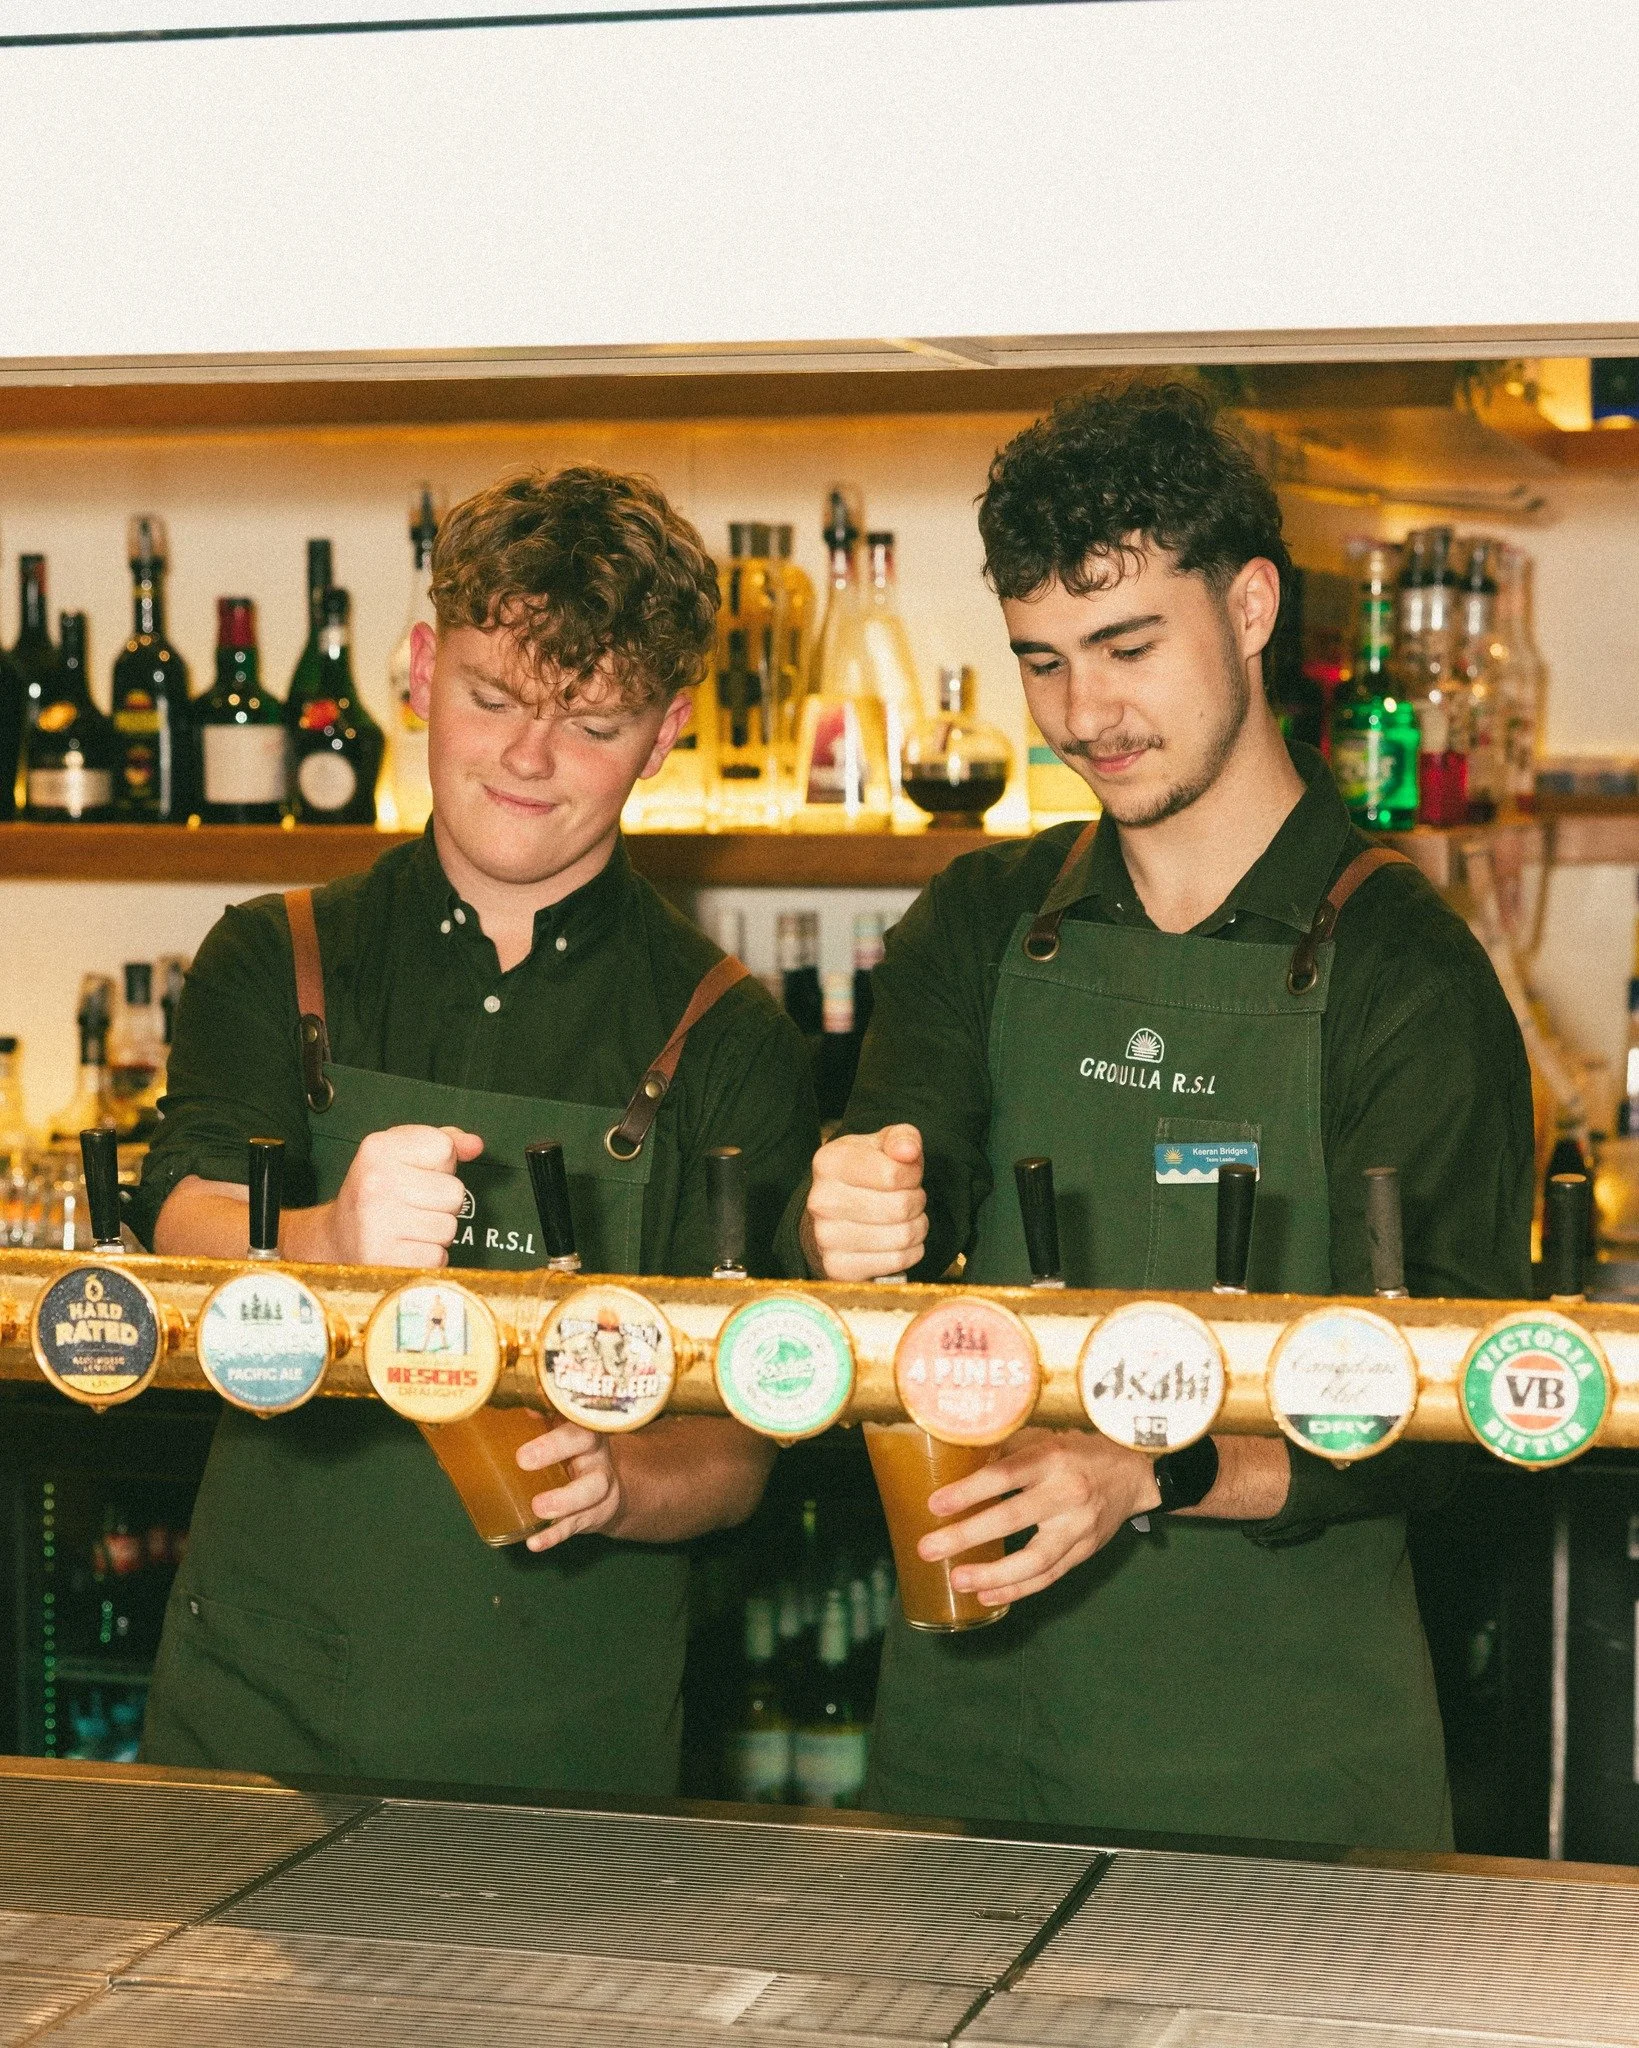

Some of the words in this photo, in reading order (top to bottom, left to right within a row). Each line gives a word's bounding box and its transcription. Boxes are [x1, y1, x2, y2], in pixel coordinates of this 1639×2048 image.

[1219, 1147, 1248, 1157] Bridges
[68, 1302, 123, 1320] HARD
[55, 1320, 139, 1347] RATED
[1475, 1327, 1595, 1382] VICTORIA
[228, 1367, 277, 1381] PACIFIC
[280, 1367, 303, 1381] ALE
[906, 1358, 927, 1385] 4
[934, 1358, 1027, 1387] PINES
[1093, 1357, 1211, 1404] Asahi
[1506, 1375, 1565, 1410] VB
[1309, 1419, 1376, 1434] DRY
[1482, 1418, 1588, 1457] BITTER
